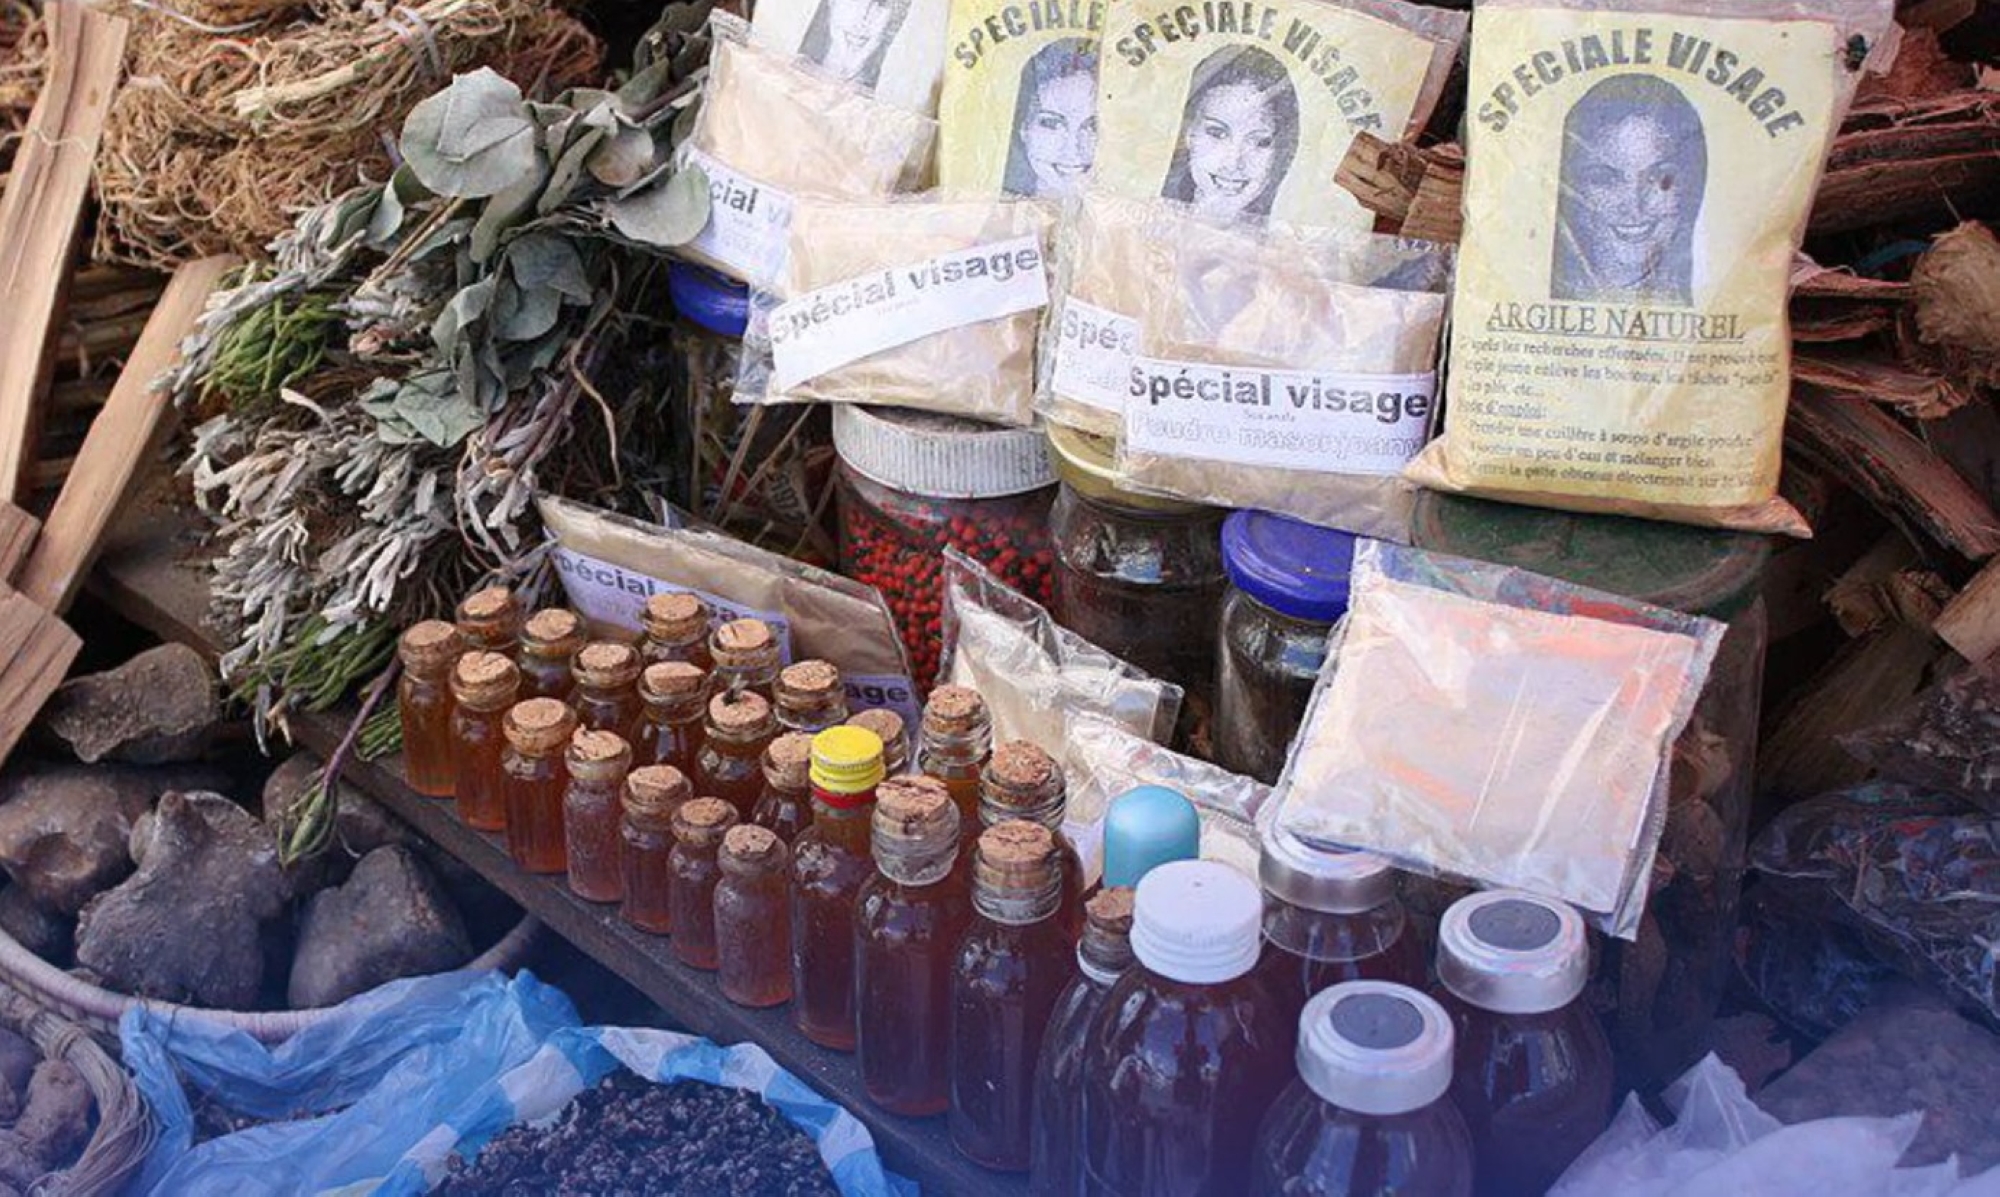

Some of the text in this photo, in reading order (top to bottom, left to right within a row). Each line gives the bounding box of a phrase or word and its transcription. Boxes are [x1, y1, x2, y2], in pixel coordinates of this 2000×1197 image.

[1116, 1, 1278, 67] SPECIALE
[1478, 28, 1804, 138] SPECIALE VISAGE
[711, 178, 760, 214] cial
[773, 248, 1040, 344] Spécial visage
[1064, 309, 1133, 356] Spéc
[1486, 301, 1746, 341] ARGILE NATUREL
[1129, 367, 1271, 405] Spécial
[1286, 377, 1428, 424] visage
[546, 554, 655, 598] pécial
[844, 682, 909, 706] age
